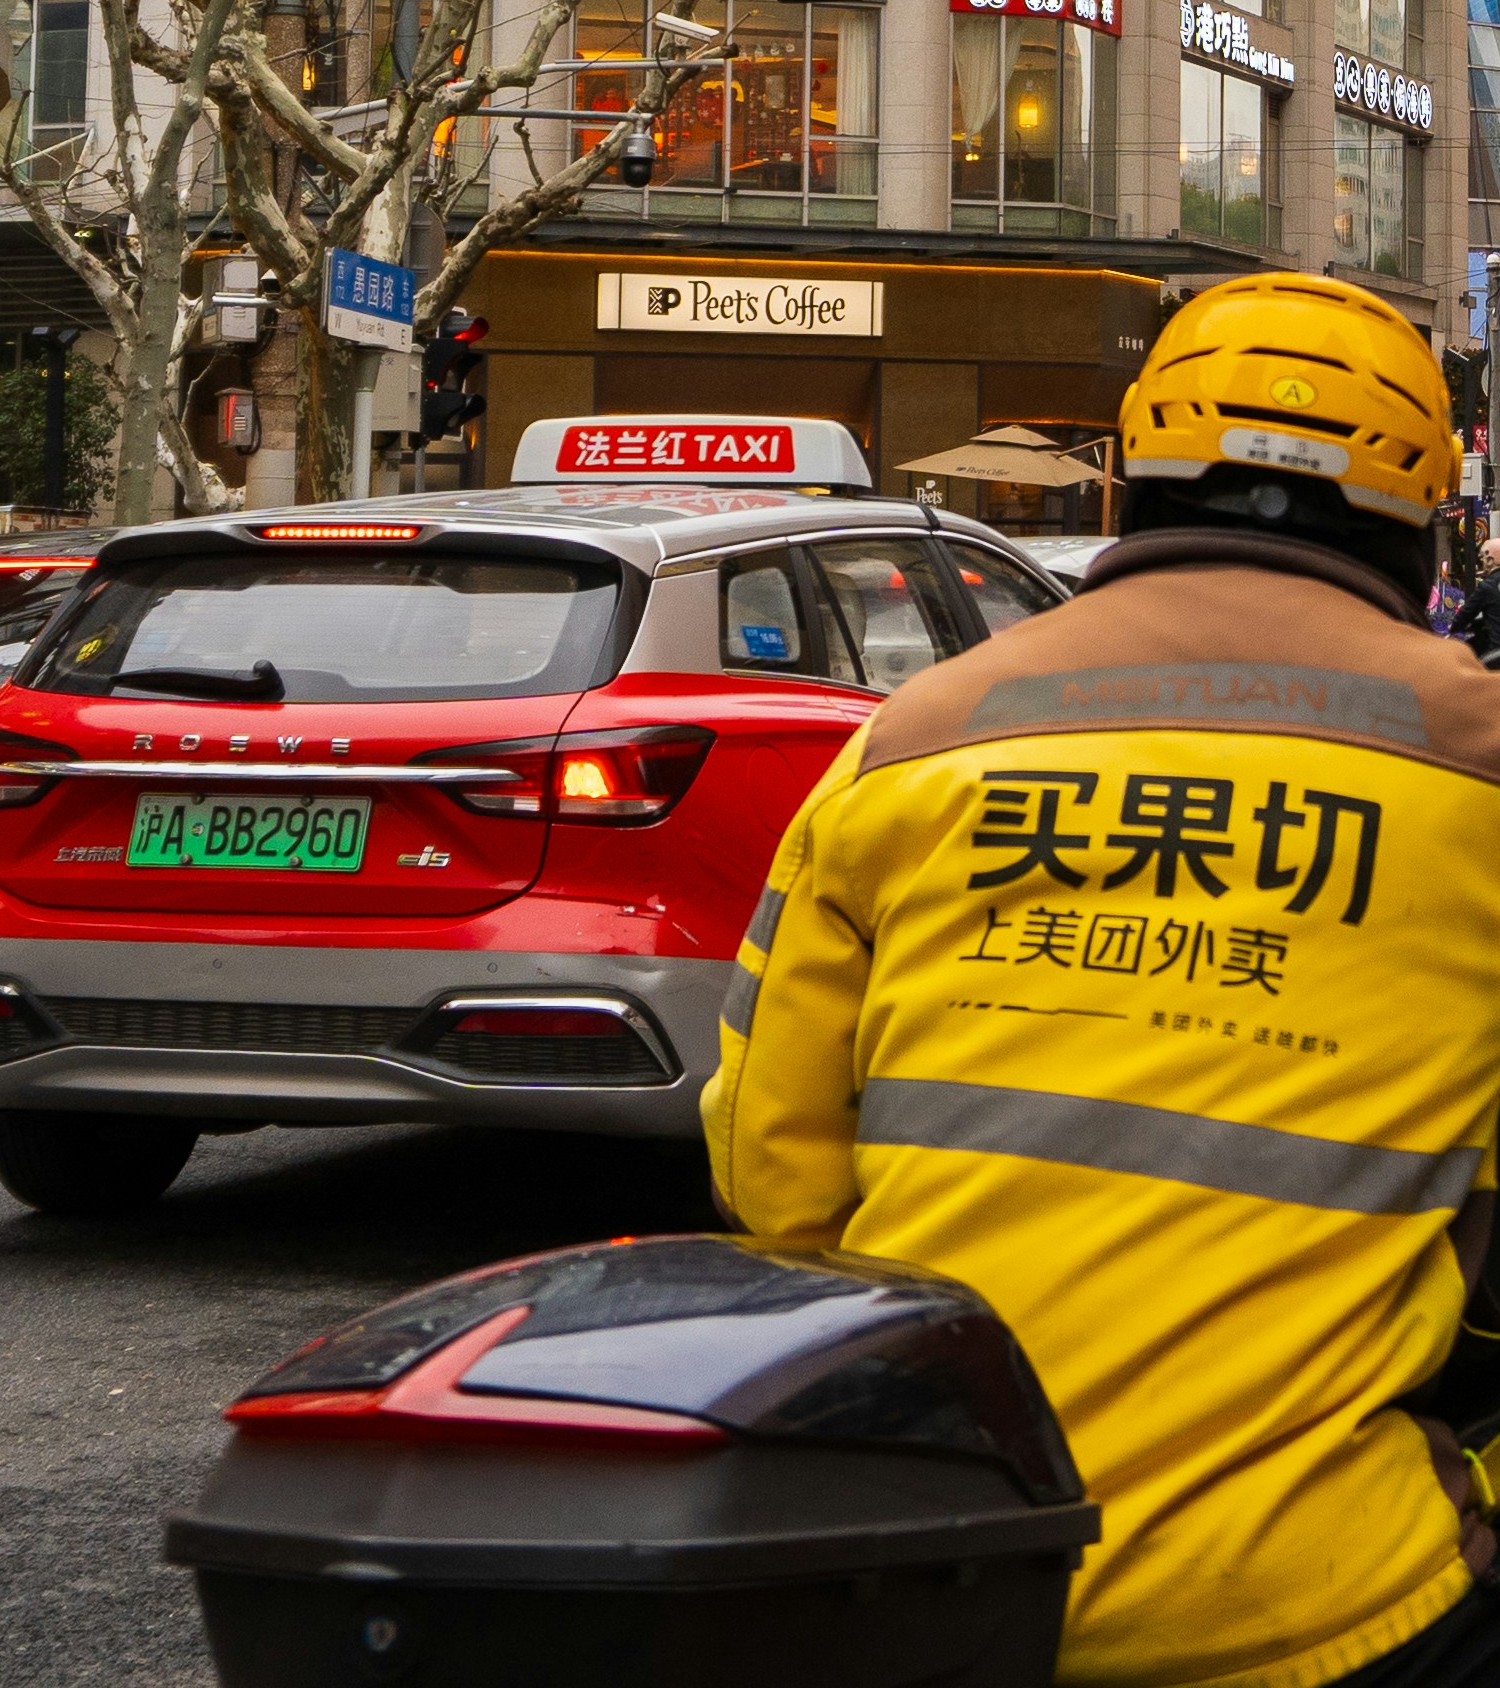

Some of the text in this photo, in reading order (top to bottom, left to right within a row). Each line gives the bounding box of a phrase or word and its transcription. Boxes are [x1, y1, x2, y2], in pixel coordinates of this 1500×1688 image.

[352, 265, 395, 313] 愚园路
[687, 280, 846, 329] Peet's Coffee
[575, 430, 781, 468] 法兰红 TAXI
[915, 487, 943, 505] Peet's
[132, 733, 352, 755] ROEWE
[134, 804, 357, 859] 沪A·BB2960
[968, 769, 1383, 928] 买果切
[958, 905, 1289, 997] 上美团外卖
